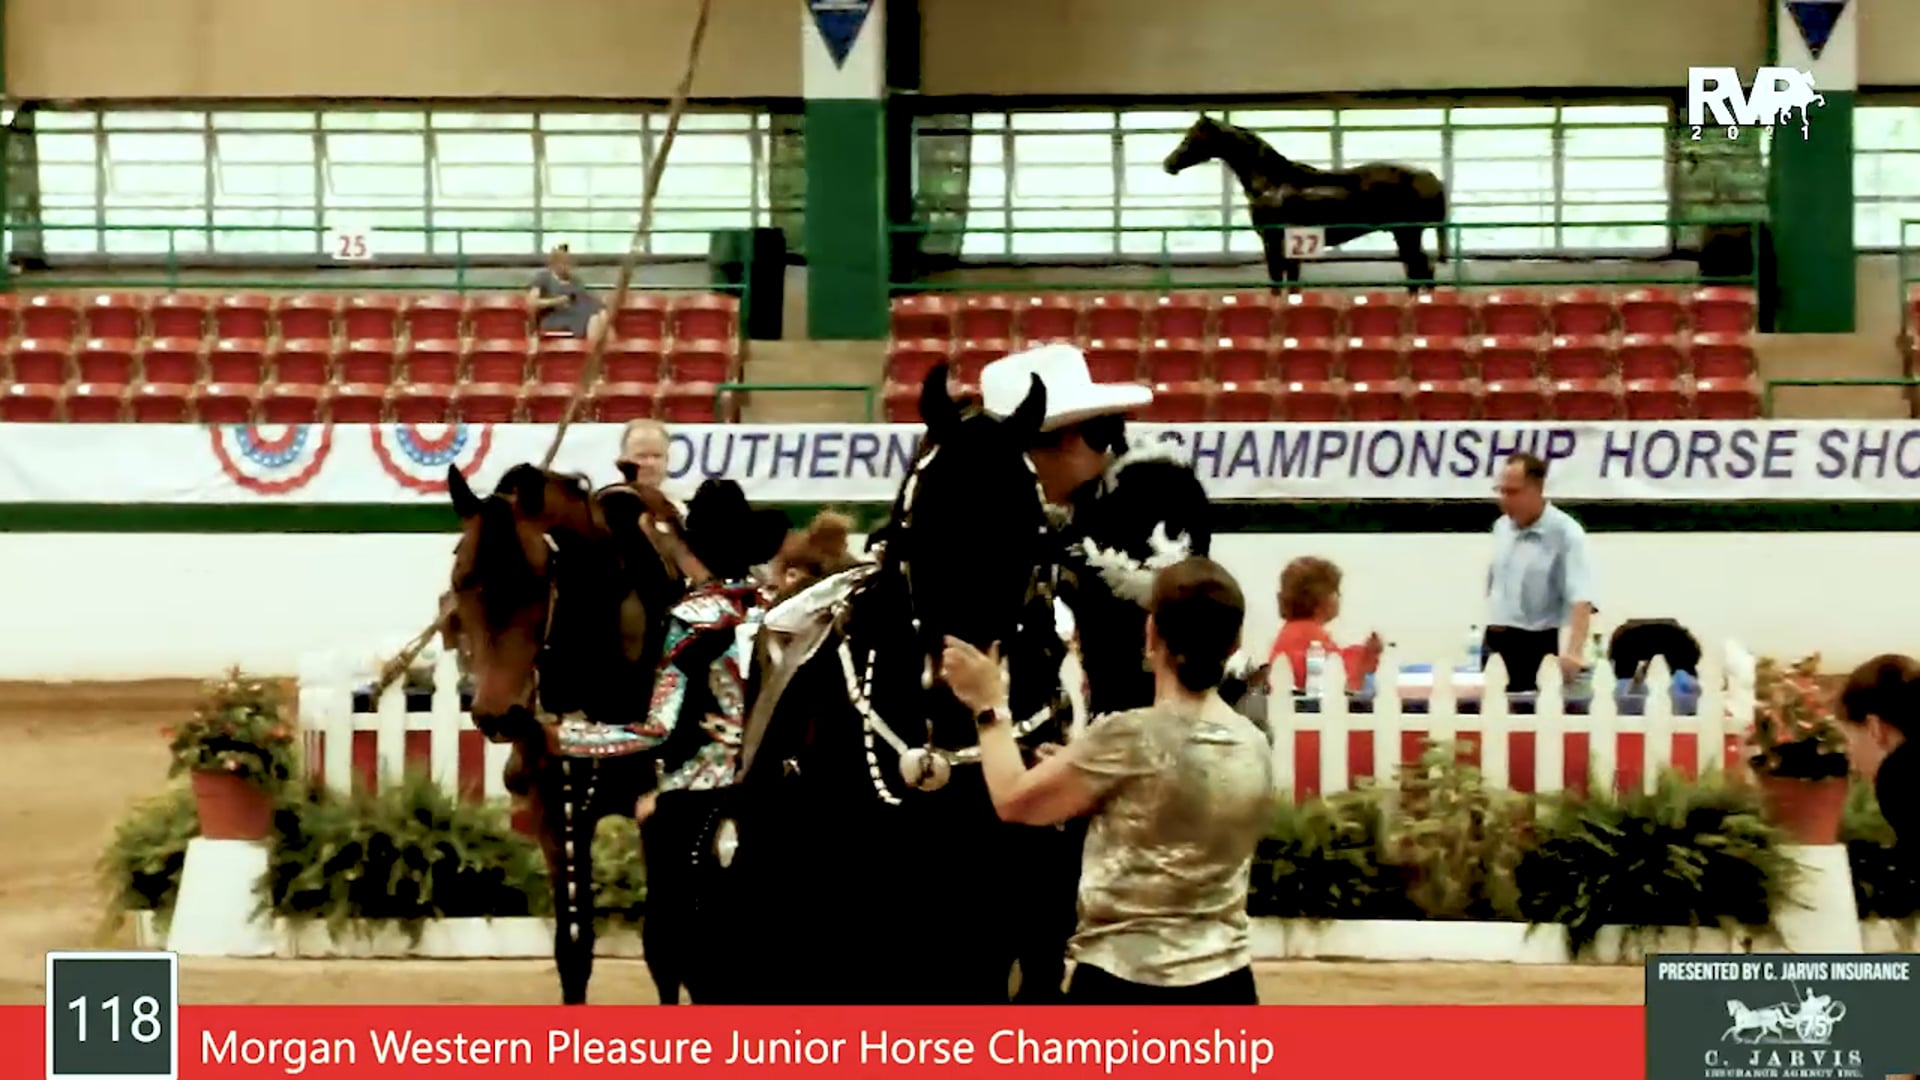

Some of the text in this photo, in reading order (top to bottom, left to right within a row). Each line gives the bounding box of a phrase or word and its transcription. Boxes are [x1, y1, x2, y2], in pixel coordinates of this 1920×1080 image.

[339, 235, 367, 257] 25
[1292, 234, 1318, 255] 27
[664, 432, 922, 479] OUTHERN
[1600, 429, 1798, 478] HORSE
